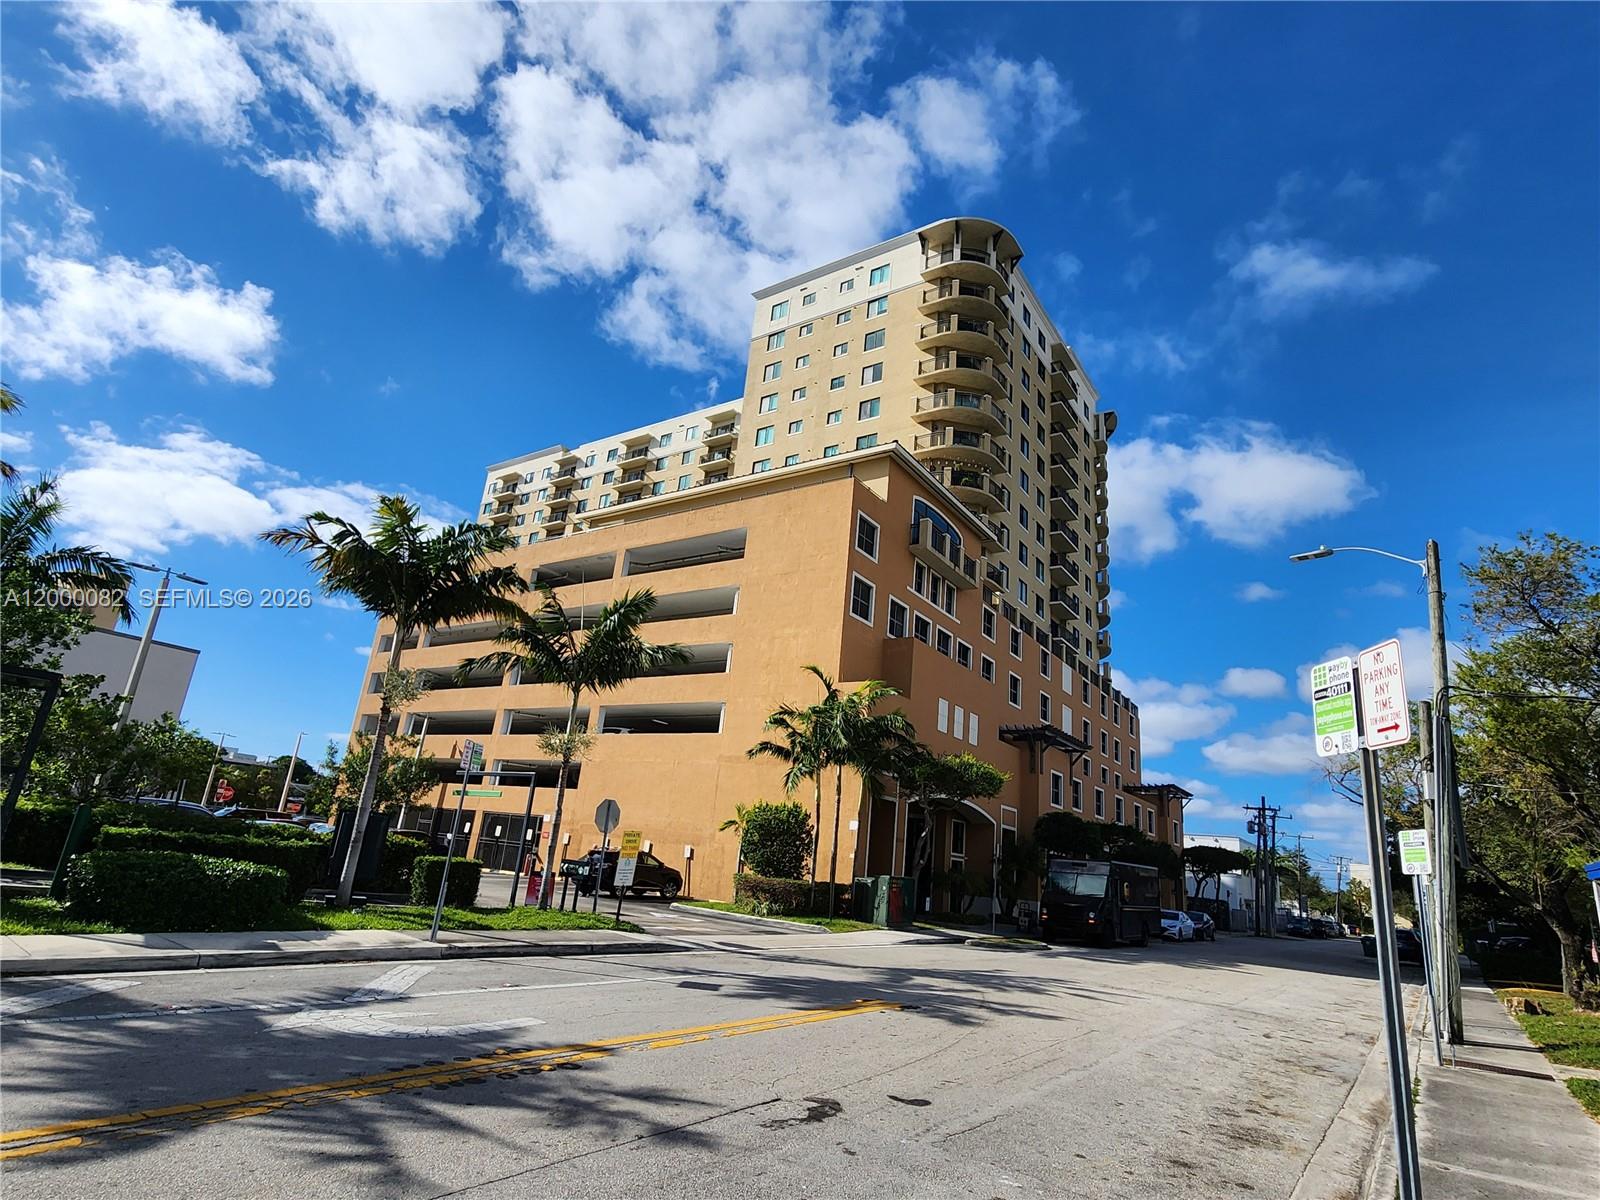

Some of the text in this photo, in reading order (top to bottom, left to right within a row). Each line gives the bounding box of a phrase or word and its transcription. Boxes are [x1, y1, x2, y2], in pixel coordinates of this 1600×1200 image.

[1373, 651, 1385, 666] NO
[1328, 672, 1350, 685] phone
[1363, 663, 1398, 684] PARKING
[1326, 683, 1349, 697] 40111
[1374, 681, 1390, 698] ANY
[1374, 697, 1394, 713] TIME
[1390, 711, 1402, 721] ZONE
